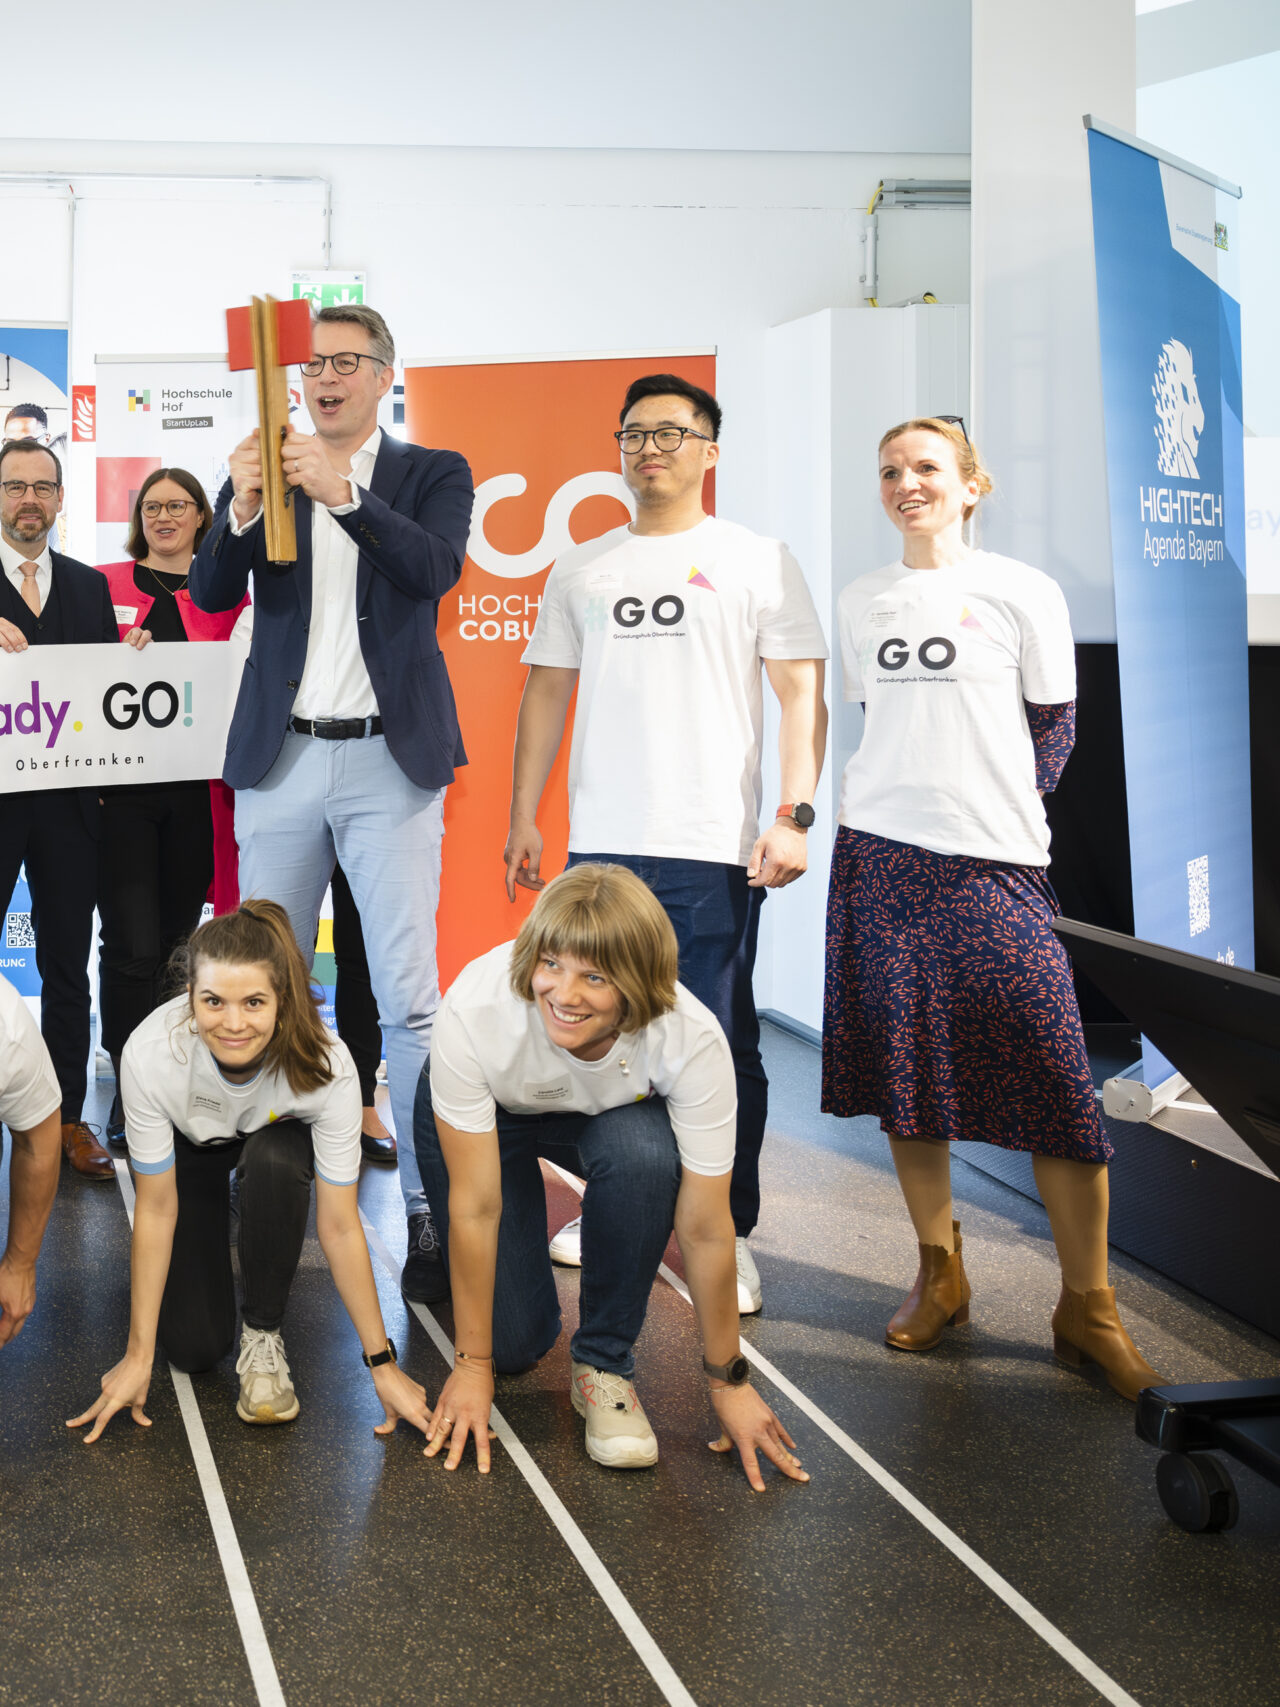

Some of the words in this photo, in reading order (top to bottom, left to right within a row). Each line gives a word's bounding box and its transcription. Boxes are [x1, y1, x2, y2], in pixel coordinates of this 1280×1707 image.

[161, 388, 233, 399] Hochschule
[161, 402, 184, 412] Hof
[166, 419, 209, 429] StartUpLab
[1140, 486, 1224, 528] HIGHTECH
[1143, 527, 1186, 567] Agenda
[1188, 530, 1224, 568] Bayern
[102, 680, 193, 730] GO!
[16, 752, 145, 771] Oberfranken
